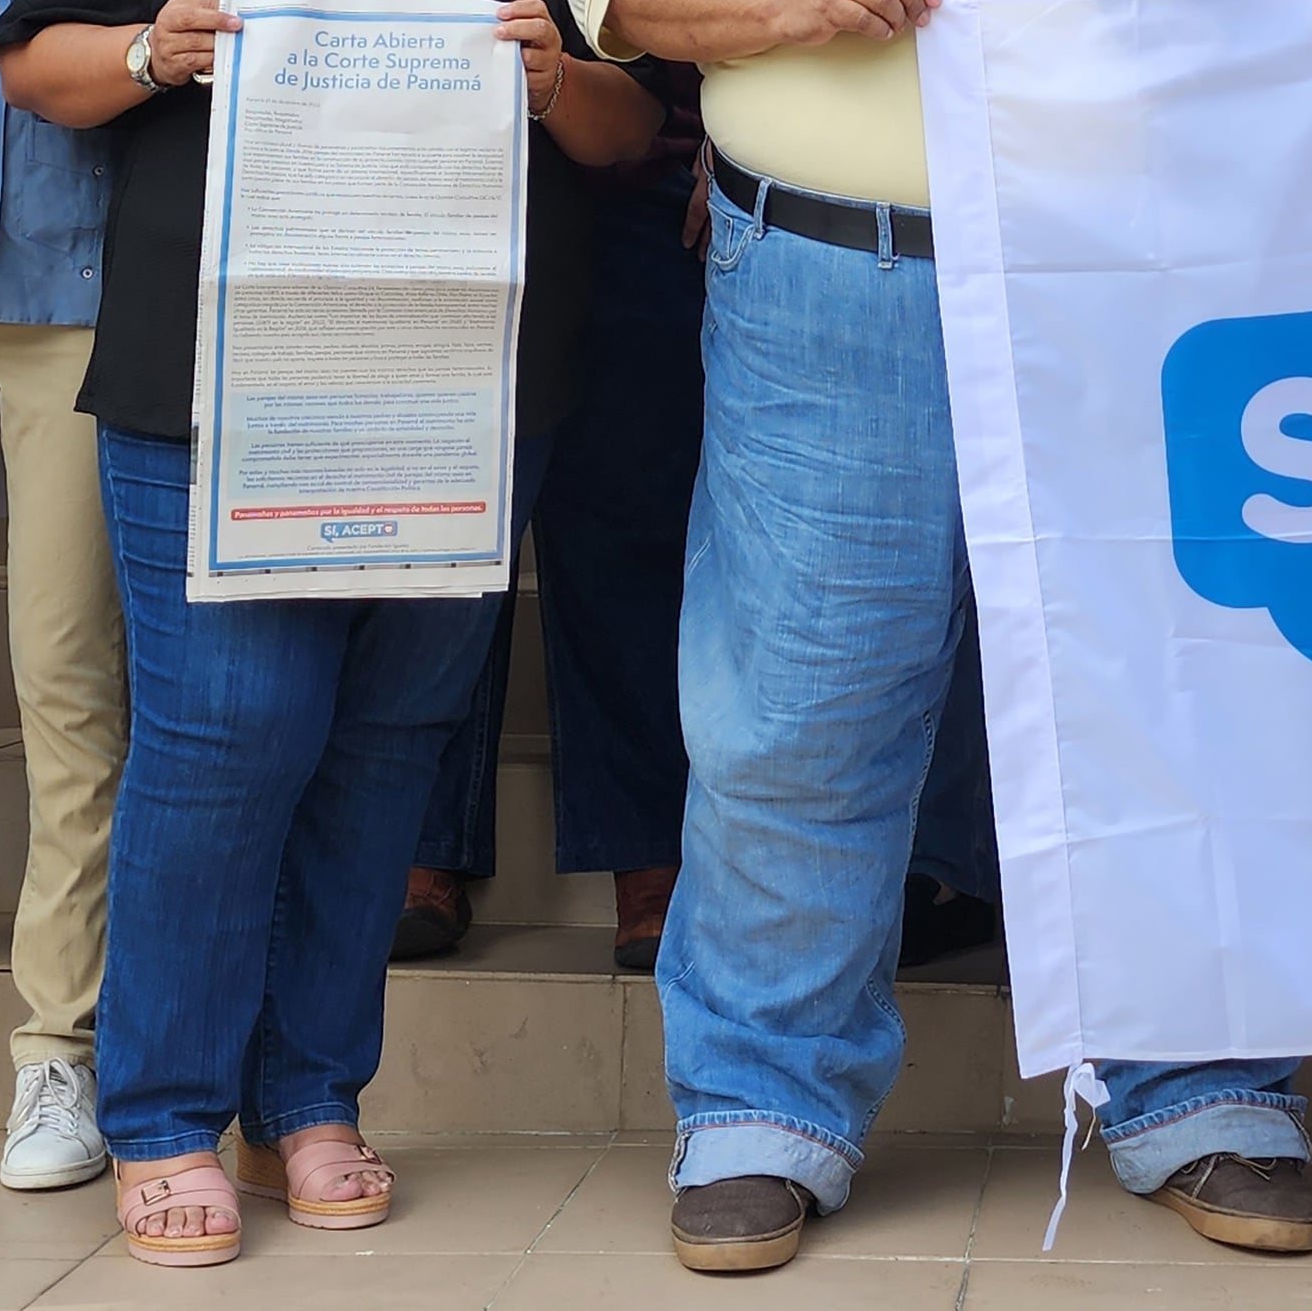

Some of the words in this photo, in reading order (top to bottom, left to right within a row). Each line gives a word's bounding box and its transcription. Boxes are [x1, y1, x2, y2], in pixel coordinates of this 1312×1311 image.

[314, 30, 368, 48] Carta
[372, 31, 446, 49] Abierta
[287, 53, 298, 65] a
[303, 49, 319, 67] la
[324, 52, 380, 69] Corte
[386, 52, 471, 73] Suprema
[274, 67, 299, 86] de
[302, 70, 371, 91] Justicia
[377, 72, 401, 90] de
[407, 74, 482, 91] Panamá
